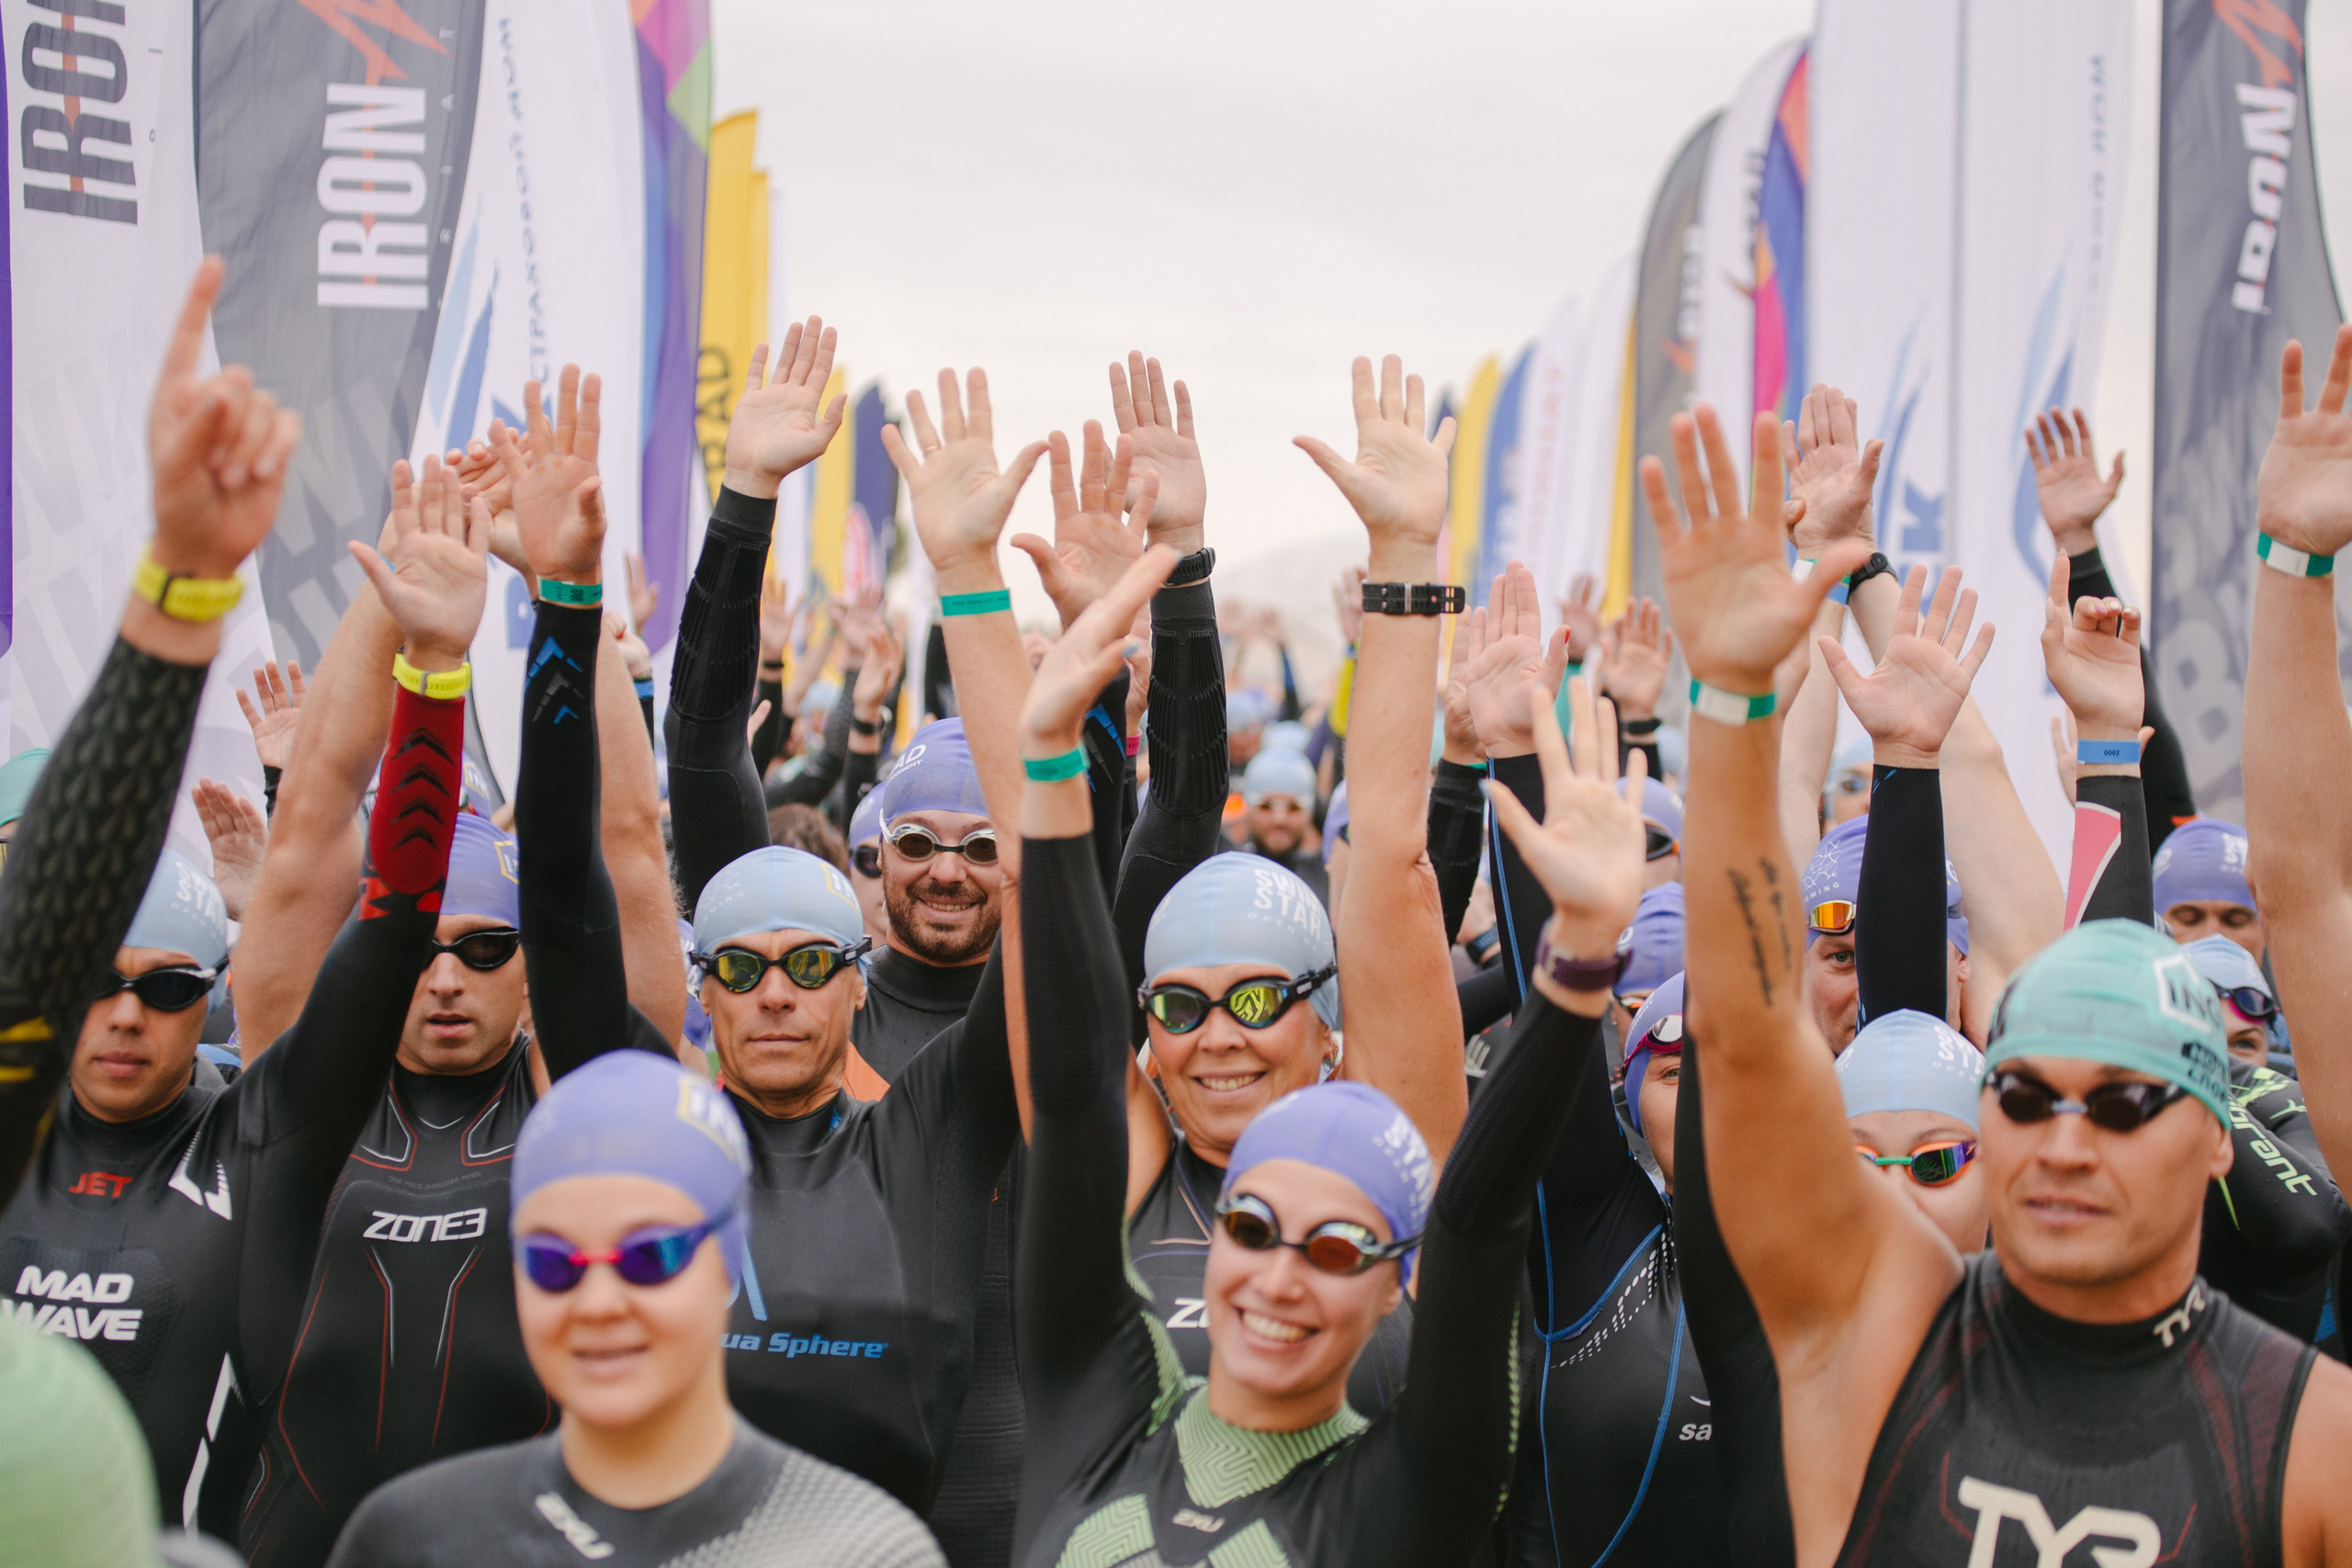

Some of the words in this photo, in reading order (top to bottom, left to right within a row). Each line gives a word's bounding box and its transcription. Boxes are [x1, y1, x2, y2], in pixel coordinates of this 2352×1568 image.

[317, 83, 429, 310] IRON
[1247, 912, 1295, 934] OPEN
[1254, 886, 1322, 942] STAR
[1932, 1061, 1976, 1085] OPEN
[68, 1170, 133, 1199] JET
[388, 1176, 402, 1185] ONE
[404, 1180, 423, 1190] PIECE
[424, 1177, 459, 1190] SHOULDER
[460, 1171, 481, 1180] PANEL
[362, 1207, 488, 1243] ZONE3
[15, 1264, 135, 1303] MAD
[1, 1298, 144, 1341] WAVE
[2153, 1283, 2206, 1348] TYR
[767, 1331, 884, 1359] Sphere
[1958, 1474, 2161, 1568] TYR
